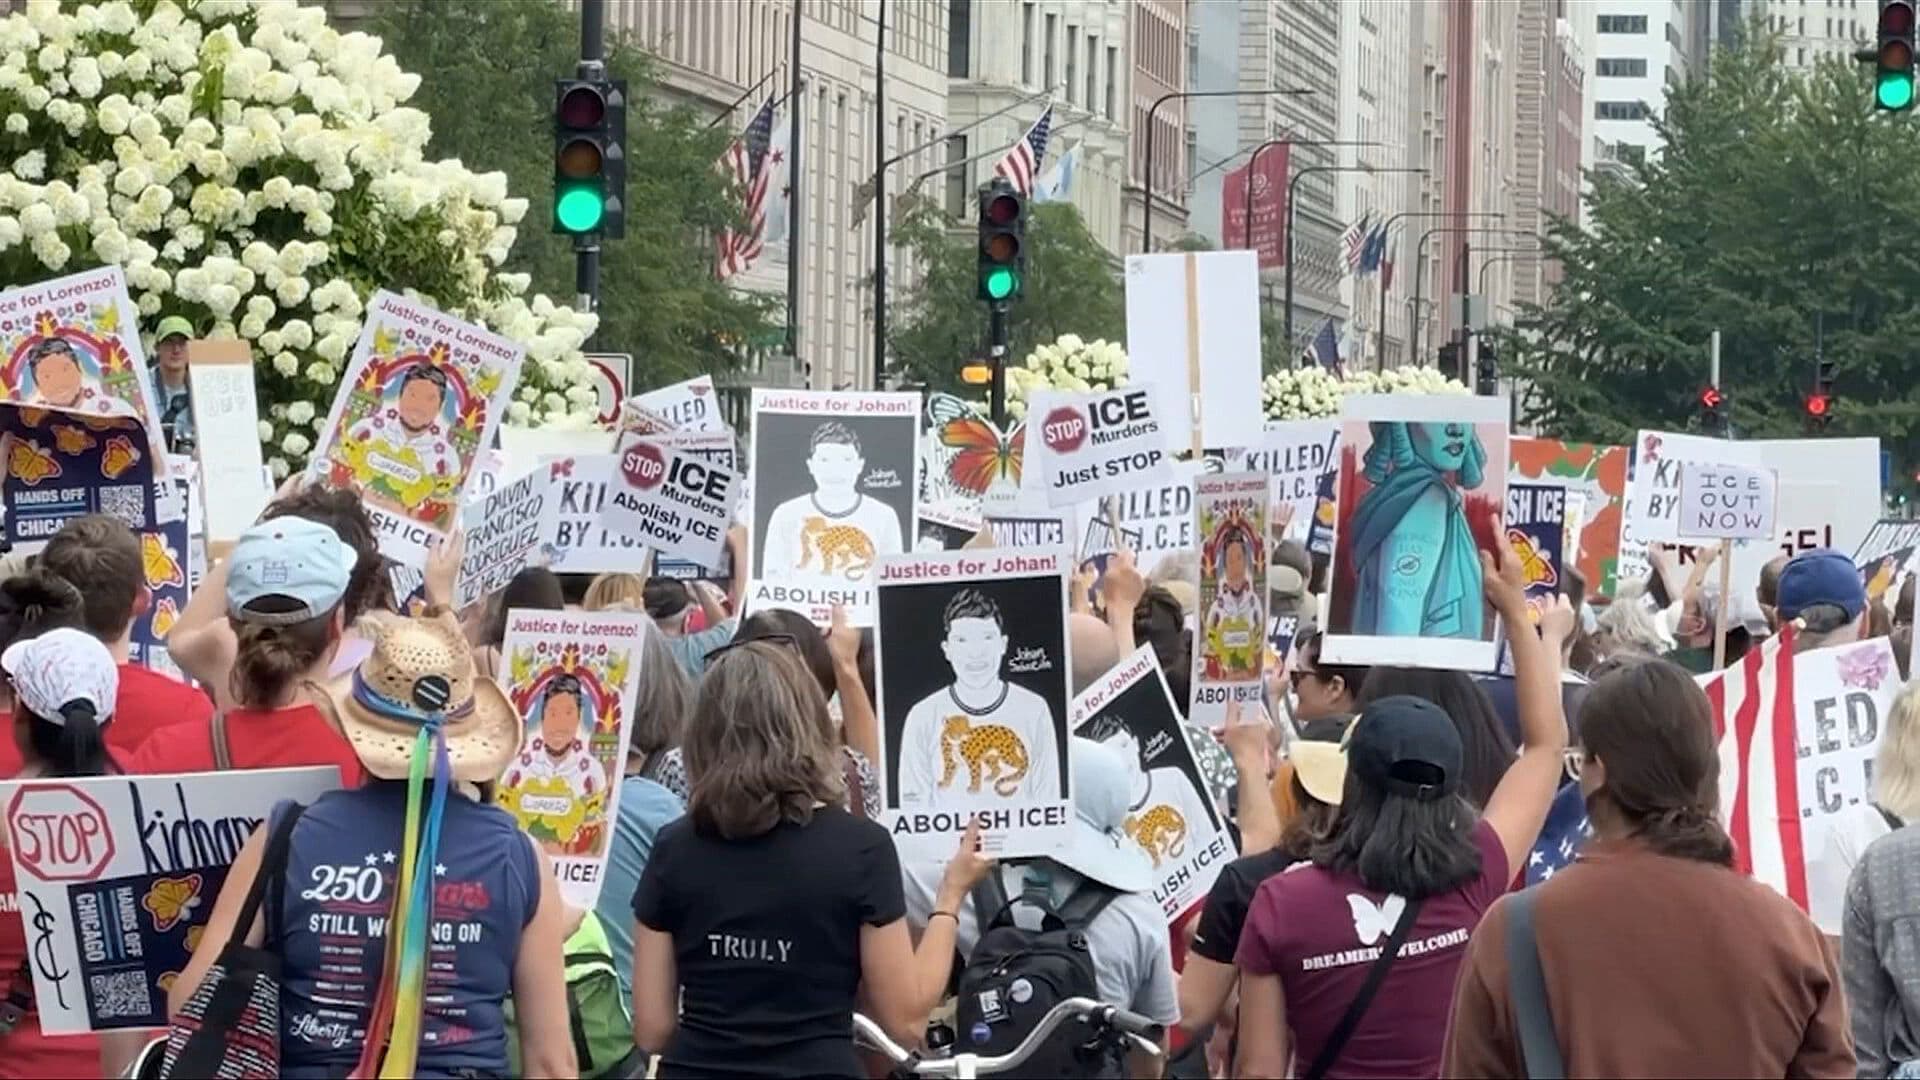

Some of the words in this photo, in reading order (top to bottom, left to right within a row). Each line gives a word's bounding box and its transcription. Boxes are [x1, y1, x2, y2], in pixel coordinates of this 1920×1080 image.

[21, 294, 43, 309] for
[47, 273, 118, 302] Lorenzo!
[379, 298, 430, 327] Justice
[432, 318, 454, 336] for
[455, 329, 518, 362] Lorenzo!
[758, 397, 820, 411] Justice
[824, 399, 849, 411] for
[855, 400, 913, 412] Johan!
[1088, 390, 1150, 430] ICE
[1045, 418, 1083, 443] STOP
[1090, 421, 1159, 447] Murders
[623, 451, 662, 480] STOP
[1053, 463, 1100, 488] Just
[1104, 449, 1162, 477] STOP
[1246, 443, 1325, 476] KILLED
[667, 456, 731, 503] ICE
[1699, 473, 1761, 490] ICE
[14, 489, 59, 505] HANDS
[60, 487, 86, 502] OFF
[660, 484, 727, 519] Murders
[1098, 485, 1192, 522] KILLED
[1536, 490, 1563, 523] ICE
[1648, 493, 1679, 519] BY
[1700, 493, 1760, 510] OUT
[16, 518, 68, 537] CHICA
[612, 491, 681, 529] Abolish
[685, 517, 720, 543] ICE
[1698, 512, 1763, 530] NOW
[555, 520, 591, 547] BY
[639, 518, 683, 545] Now
[879, 561, 951, 580] Justice
[957, 558, 986, 576] for
[992, 554, 1057, 574] Johan!
[756, 585, 857, 606] ABOLISH
[511, 618, 557, 634] Justice
[560, 619, 580, 635] for
[582, 621, 638, 638] Lorenzo!
[1014, 647, 1047, 662] Johan
[1084, 690, 1107, 712] for
[1107, 655, 1151, 694] Johan!
[893, 808, 1011, 835] ABOLSH
[1019, 806, 1067, 828] ICE!
[17, 812, 99, 865] STOP
[301, 865, 384, 903] 250
[563, 863, 600, 883] ICE!
[1152, 867, 1192, 904] LISH
[1192, 836, 1227, 873] ICE!
[116, 886, 138, 932] HANDS
[75, 892, 106, 963] CHICAGO
[309, 913, 360, 936] STILL
[458, 922, 483, 942] ON
[123, 931, 144, 957] OFF
[707, 933, 793, 963] TRULY
[1302, 946, 1384, 971] DREAMER
[289, 1013, 352, 1049] Liberty
